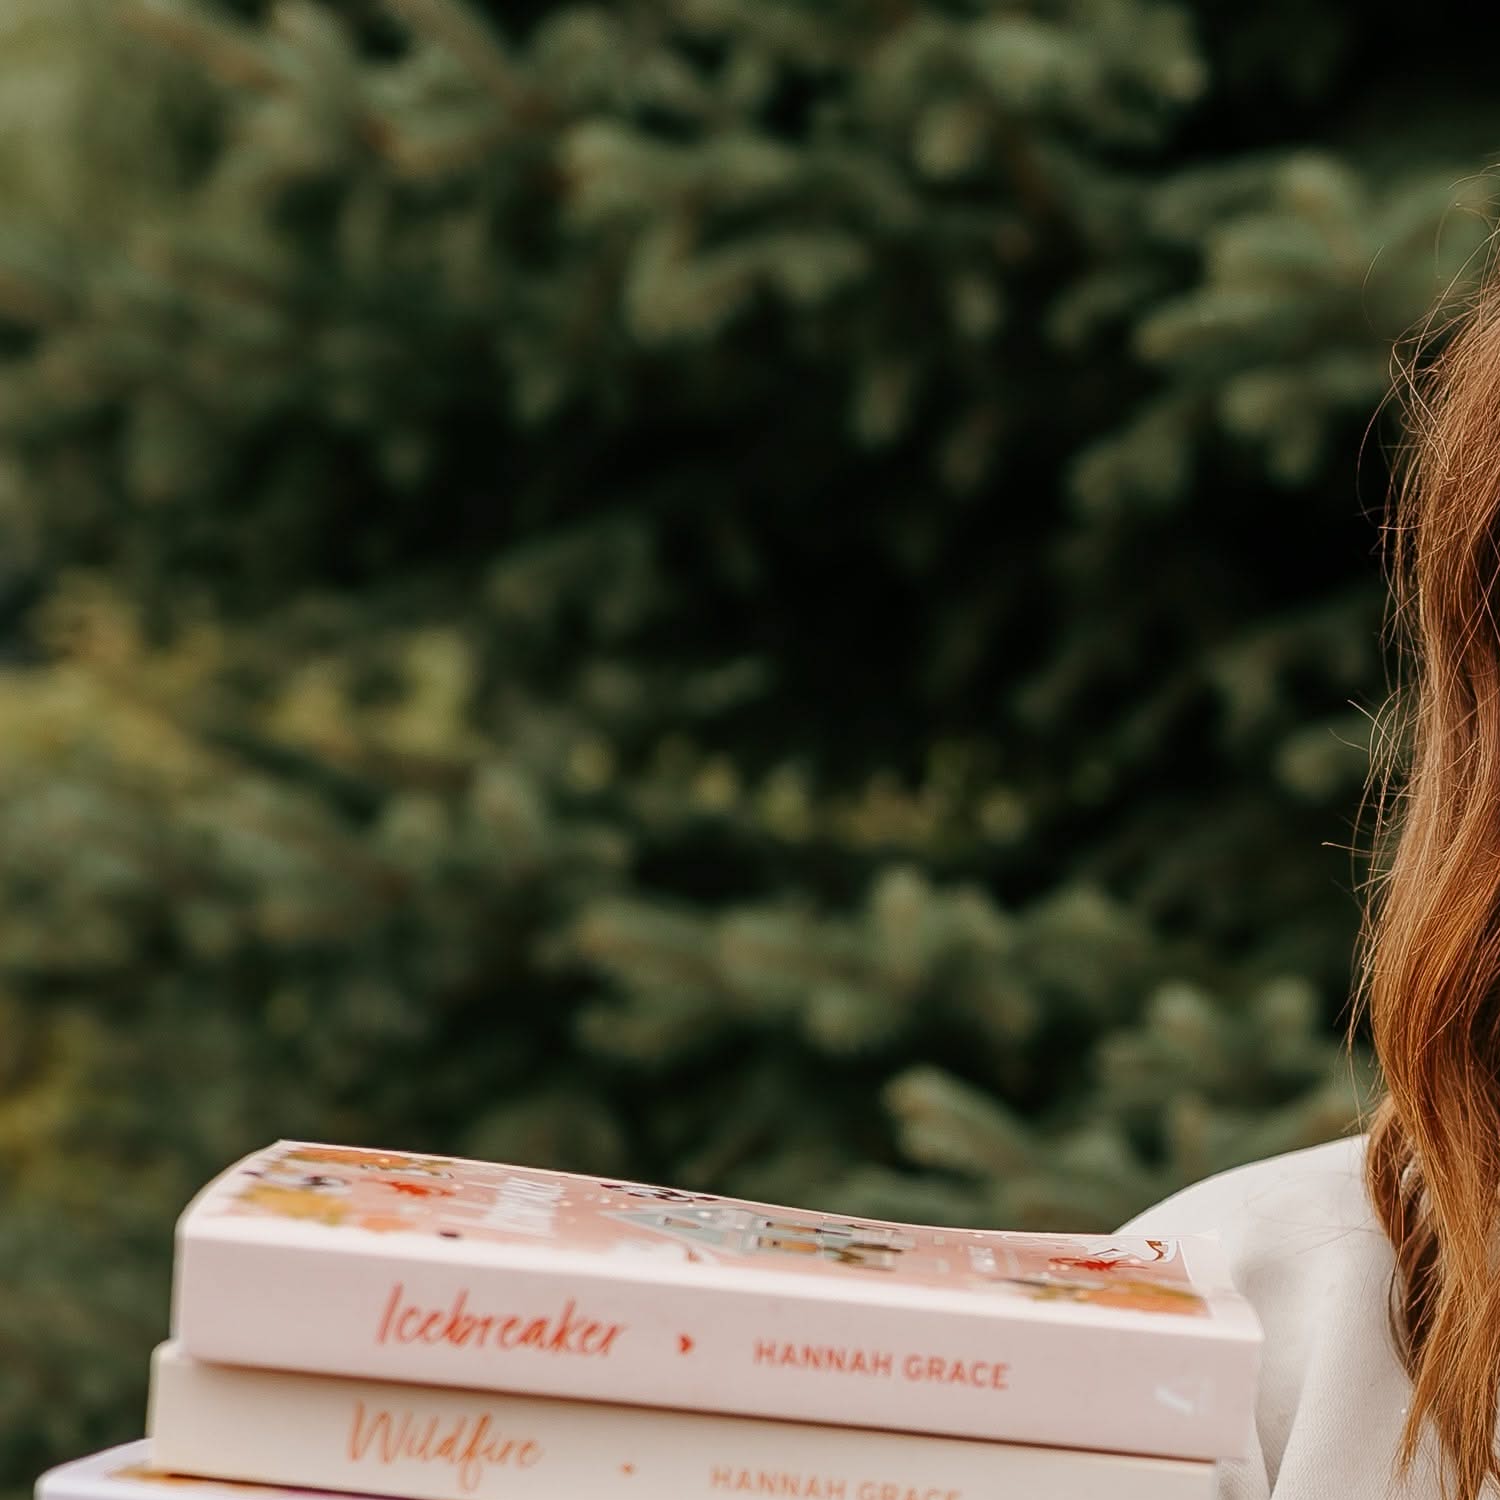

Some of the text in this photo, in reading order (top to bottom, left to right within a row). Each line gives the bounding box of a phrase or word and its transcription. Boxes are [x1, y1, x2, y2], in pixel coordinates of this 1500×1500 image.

[378, 1282, 1011, 1391] Icebreaker HANNAH GRACE
[349, 1401, 544, 1491] Wildfire
